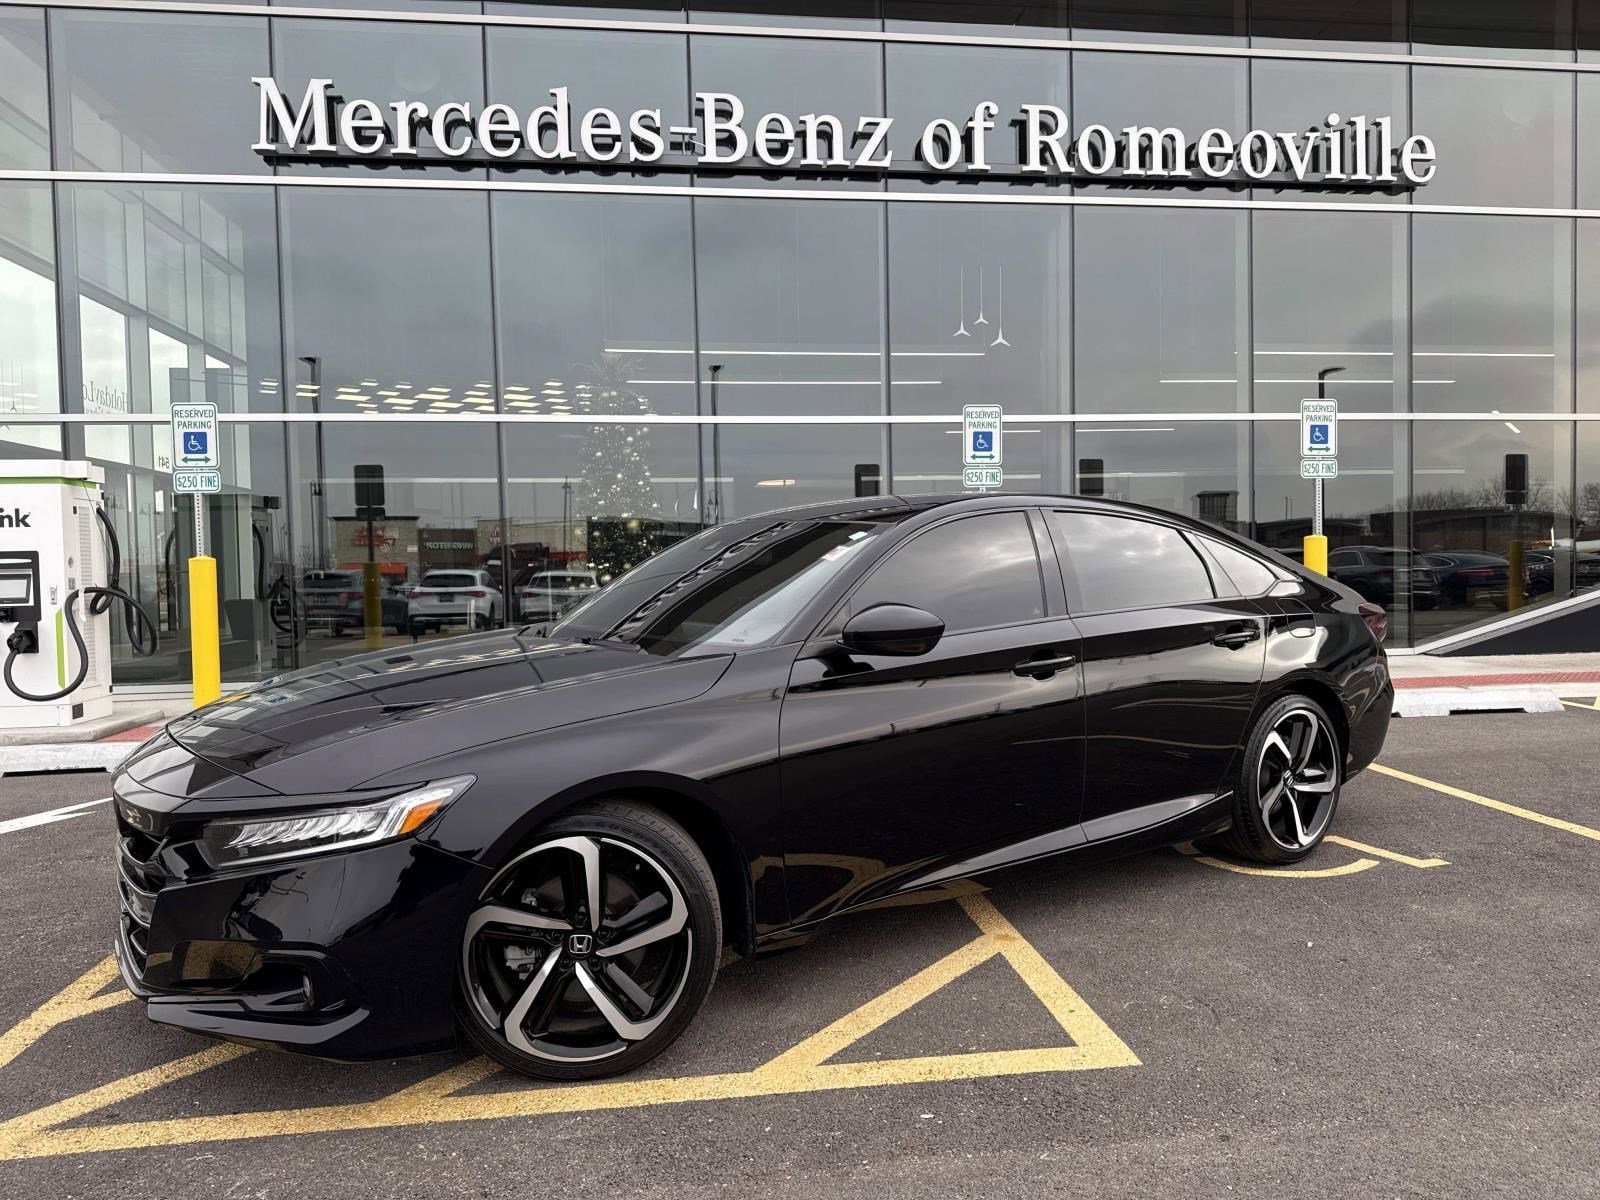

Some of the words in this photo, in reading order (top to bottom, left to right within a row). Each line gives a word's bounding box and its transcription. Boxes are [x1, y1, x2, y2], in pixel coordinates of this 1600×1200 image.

[251, 76, 895, 168] Mercedes-Benz
[922, 101, 999, 171] of
[1021, 104, 1436, 183] Romeoville
[1303, 404, 1335, 413] RESERVED
[173, 409, 214, 418] RESERVED
[966, 410, 1000, 419] RESERVED
[1305, 414, 1333, 422] PARKING
[177, 420, 212, 429] PARKING
[968, 421, 997, 429] PARKING
[1303, 463, 1320, 474] $250
[1321, 463, 1335, 474] FINE
[966, 471, 984, 482] $250
[985, 471, 1000, 482] FINE
[177, 475, 198, 488] $250
[200, 475, 217, 488] FINE
